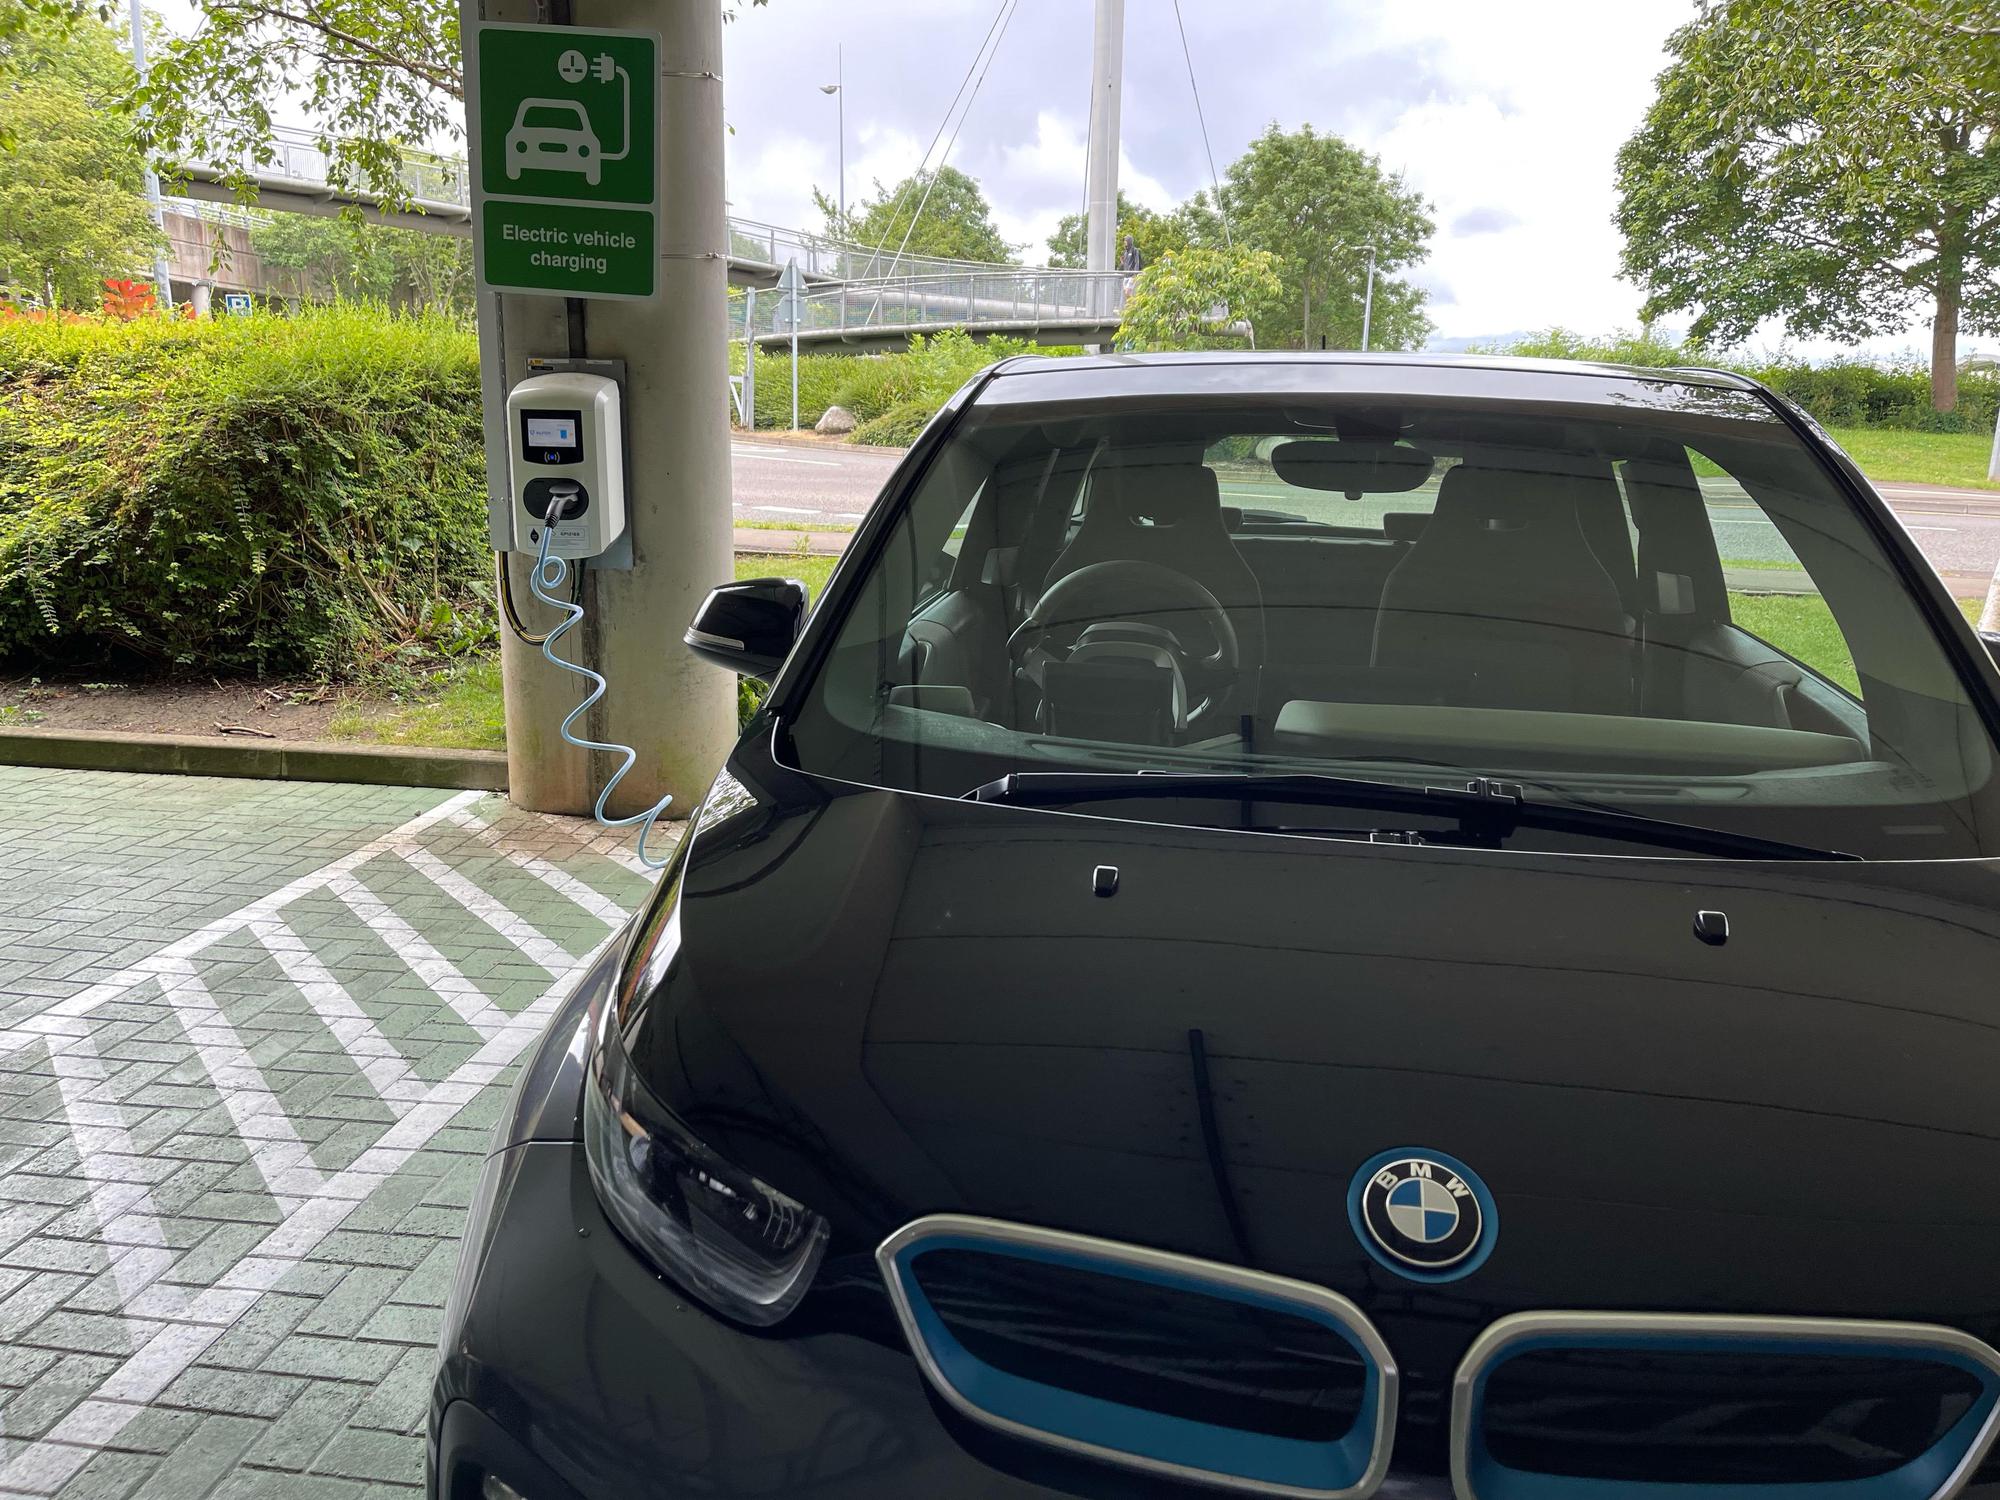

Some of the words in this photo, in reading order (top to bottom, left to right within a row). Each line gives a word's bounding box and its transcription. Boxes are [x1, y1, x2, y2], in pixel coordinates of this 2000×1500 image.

[502, 224, 569, 244] Electric
[573, 230, 636, 249] vehicle
[530, 251, 607, 274] charging
[1376, 1162, 1470, 1198] BMW
